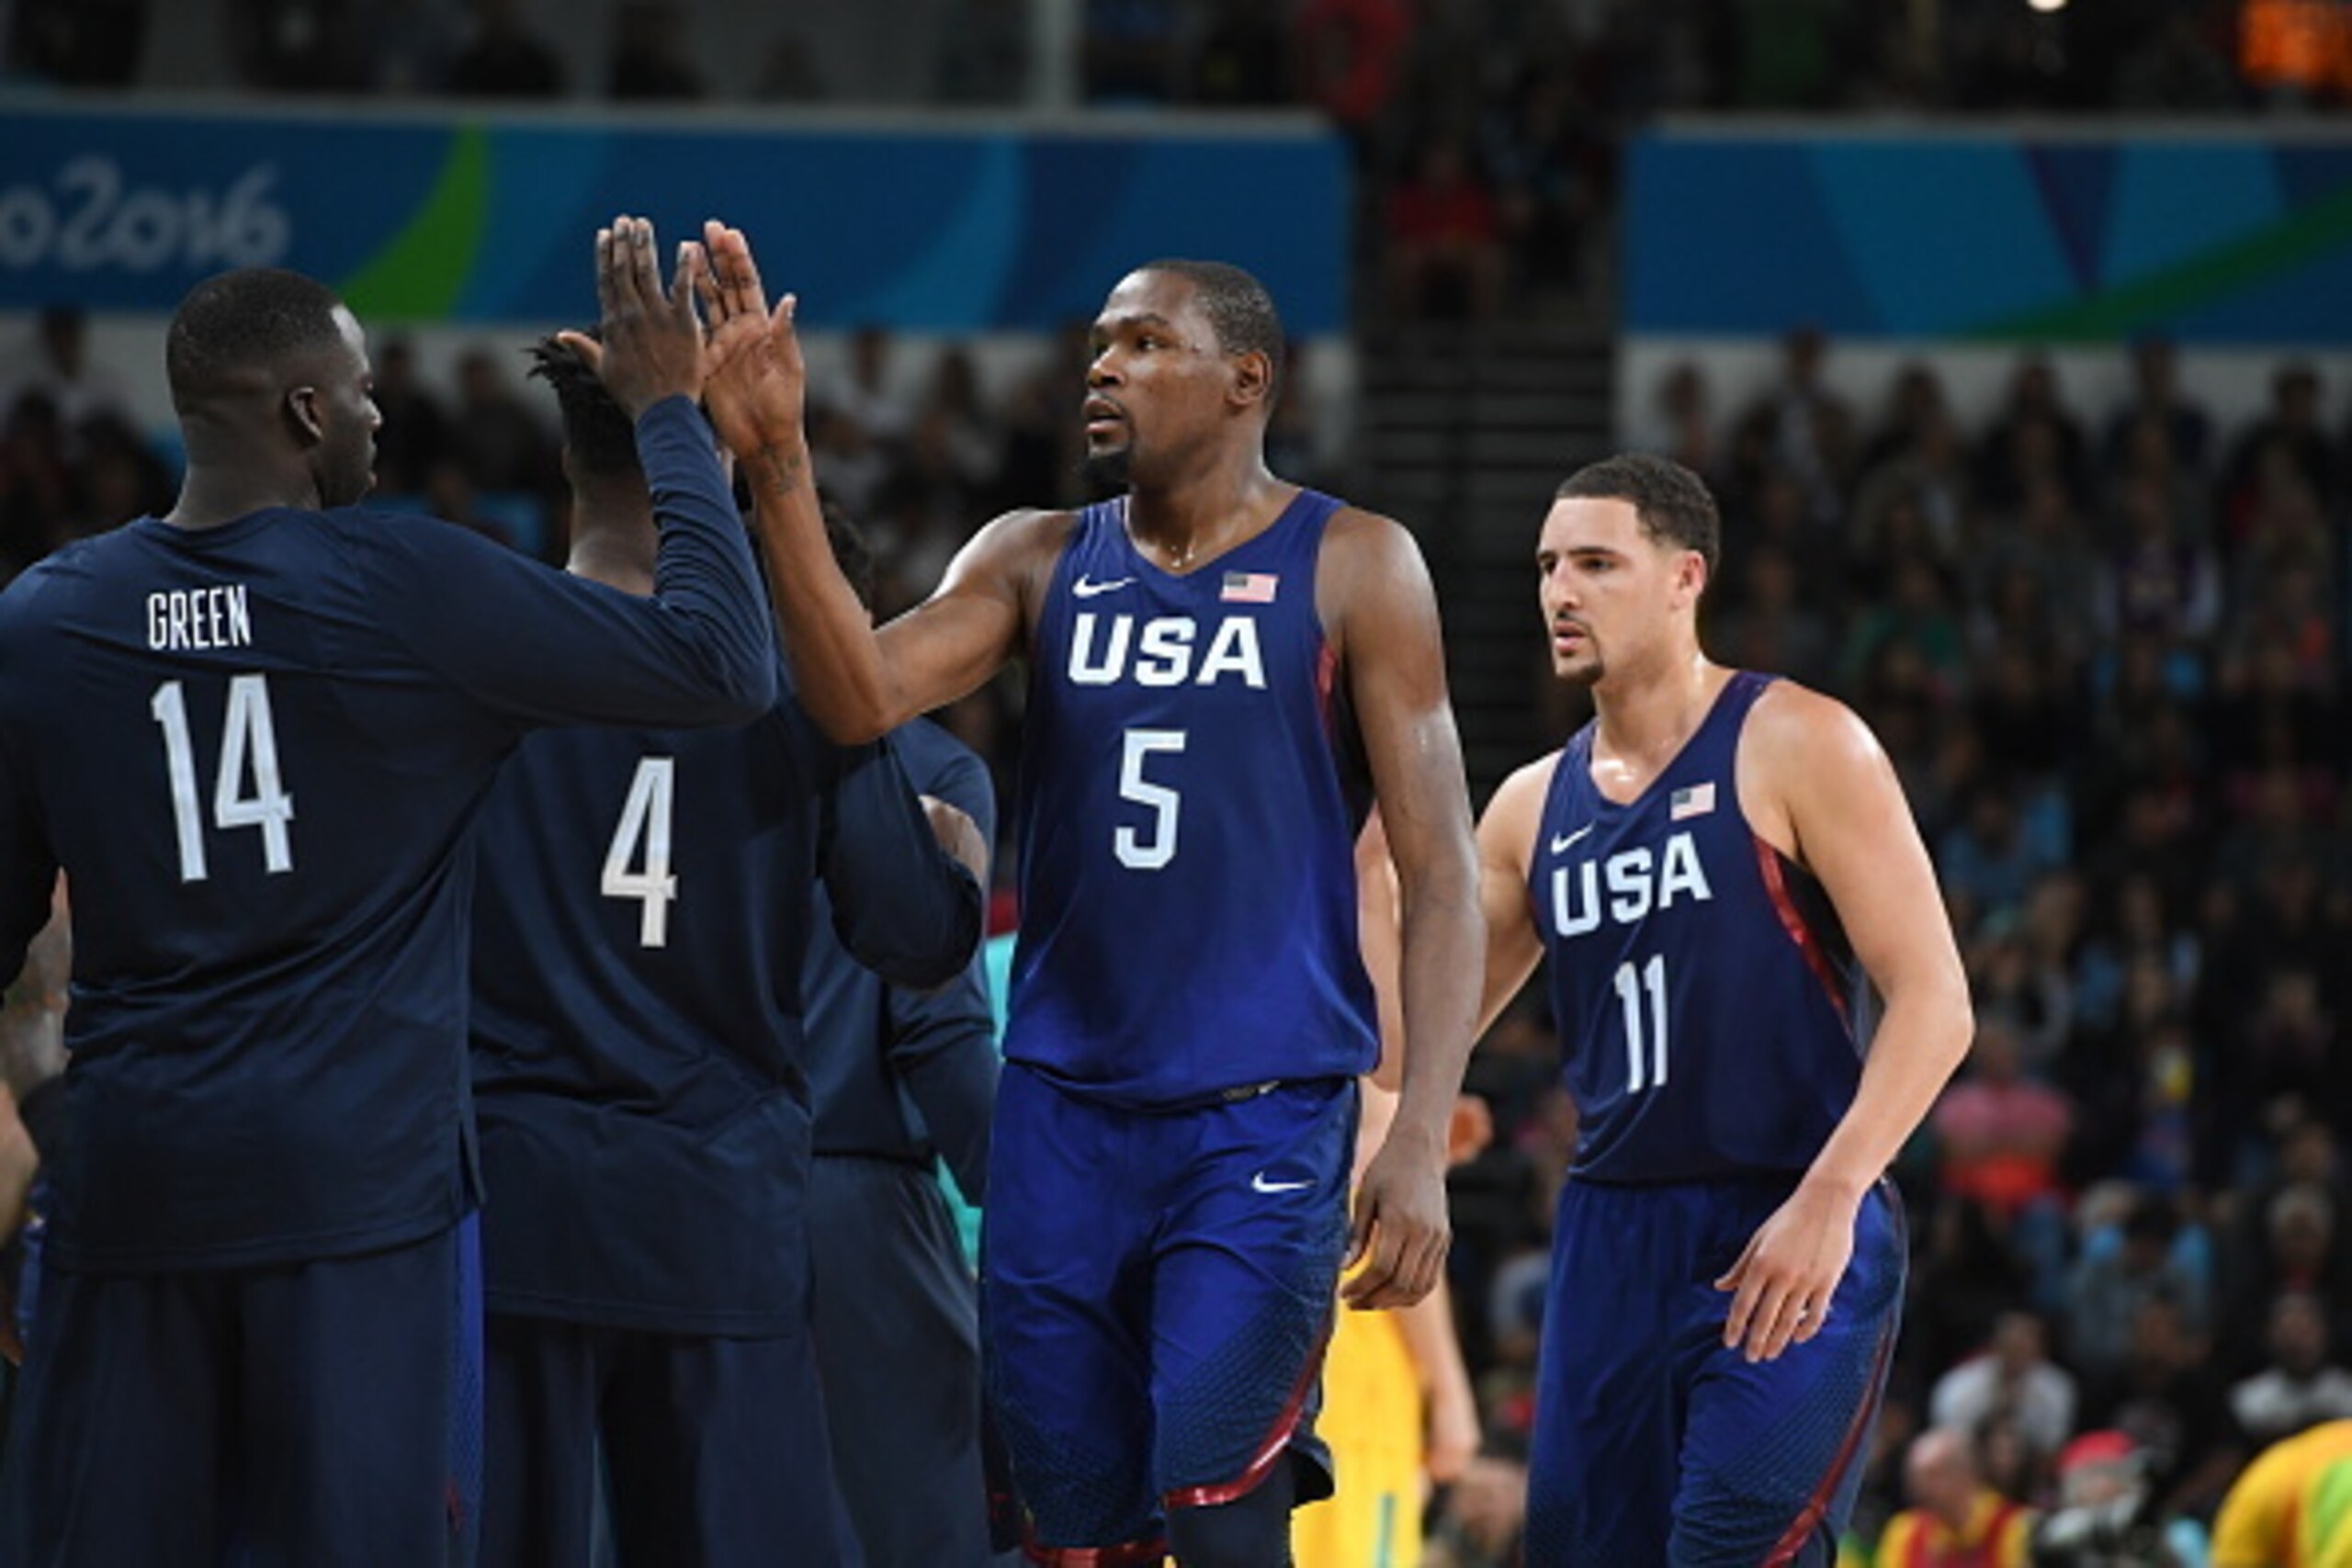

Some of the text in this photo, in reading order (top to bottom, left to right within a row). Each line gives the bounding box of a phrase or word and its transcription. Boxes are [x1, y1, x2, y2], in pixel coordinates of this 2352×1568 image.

[147, 583, 252, 650] GREEN
[1069, 613, 1266, 688] USA
[151, 674, 295, 882] 14
[1114, 728, 1186, 869] 5
[601, 757, 678, 947] 4
[1552, 831, 1712, 937] USA
[1613, 953, 1668, 1093] 11
